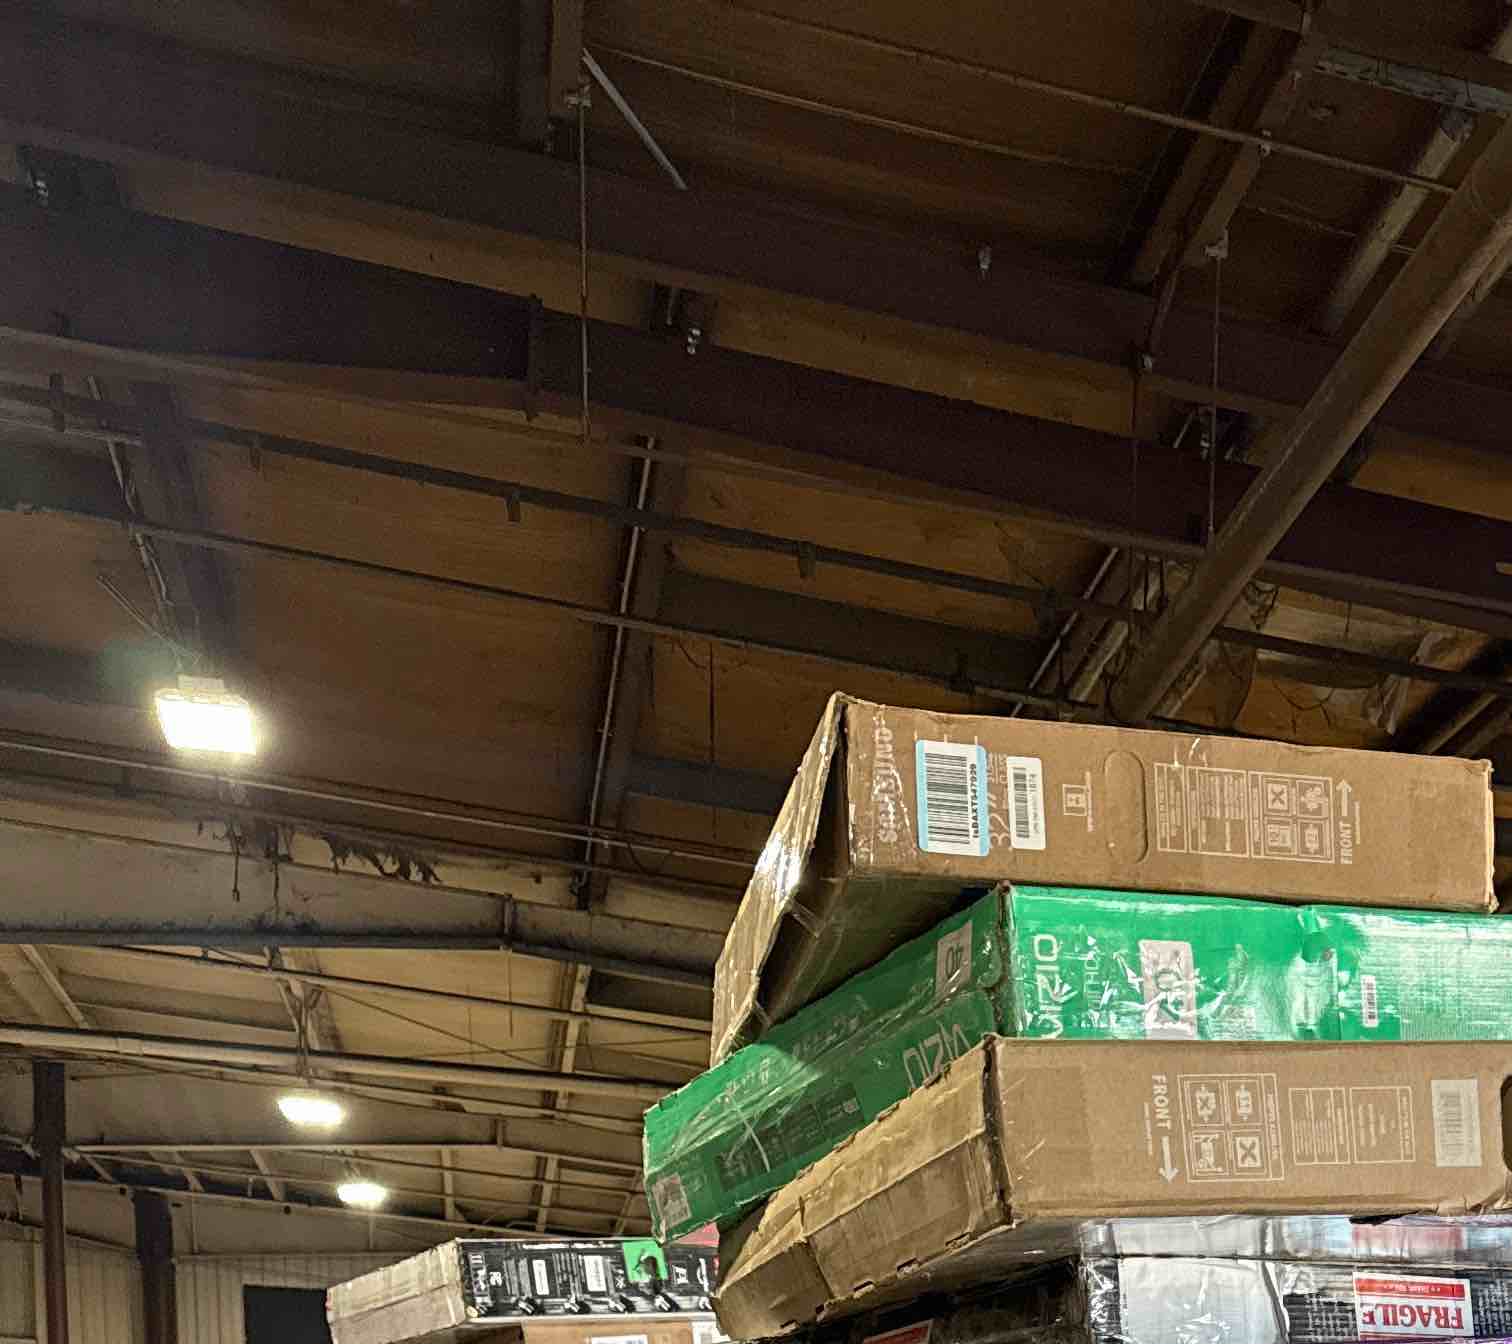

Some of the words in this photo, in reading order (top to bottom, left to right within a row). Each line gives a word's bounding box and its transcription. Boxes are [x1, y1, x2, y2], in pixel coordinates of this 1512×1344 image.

[1339, 821, 1353, 865] FRONT
[1152, 1074, 1172, 1131] FRONT
[1361, 1303, 1465, 1330] FRAGILE
